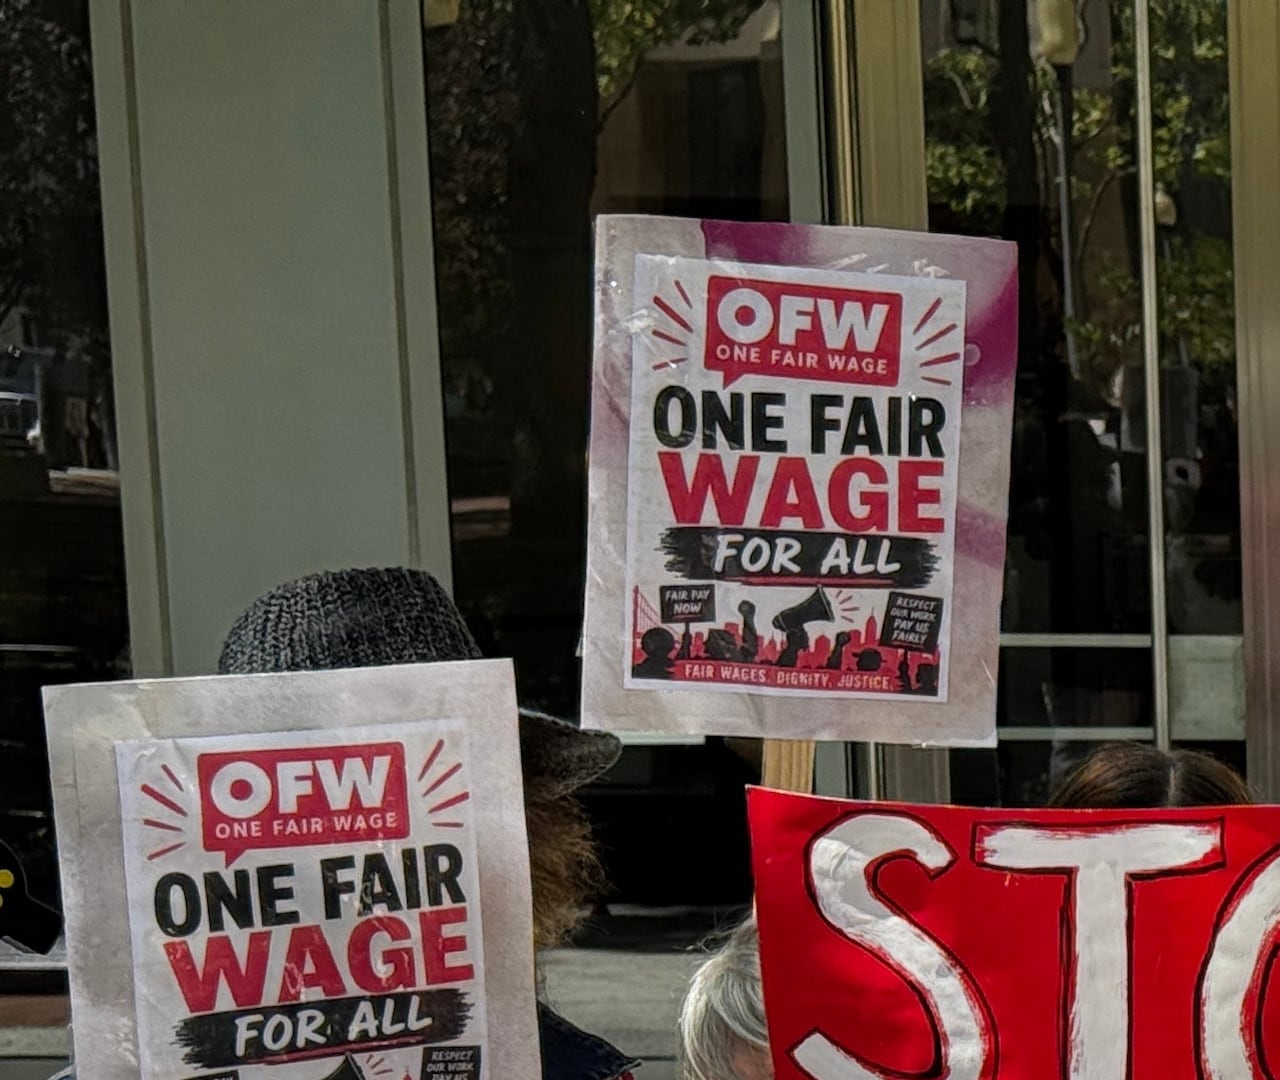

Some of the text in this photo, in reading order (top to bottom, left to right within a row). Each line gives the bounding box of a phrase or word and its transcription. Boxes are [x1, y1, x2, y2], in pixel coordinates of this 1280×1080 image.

[717, 288, 890, 353] OFW
[716, 344, 889, 376] ONE FAIR WAGE
[654, 385, 947, 458] ONE FAIR
[657, 452, 945, 535] WAGE
[714, 534, 901, 575] FOR ALL
[665, 588, 710, 601] FAIR PAY
[674, 602, 702, 614] NOW
[685, 664, 714, 679] FAIR
[210, 755, 391, 818] OFW
[215, 812, 398, 839] ONE FAIR WAGE
[154, 844, 464, 937] ONE FAIR
[163, 907, 474, 1014] WAGE
[234, 996, 432, 1057] FOR ALL
